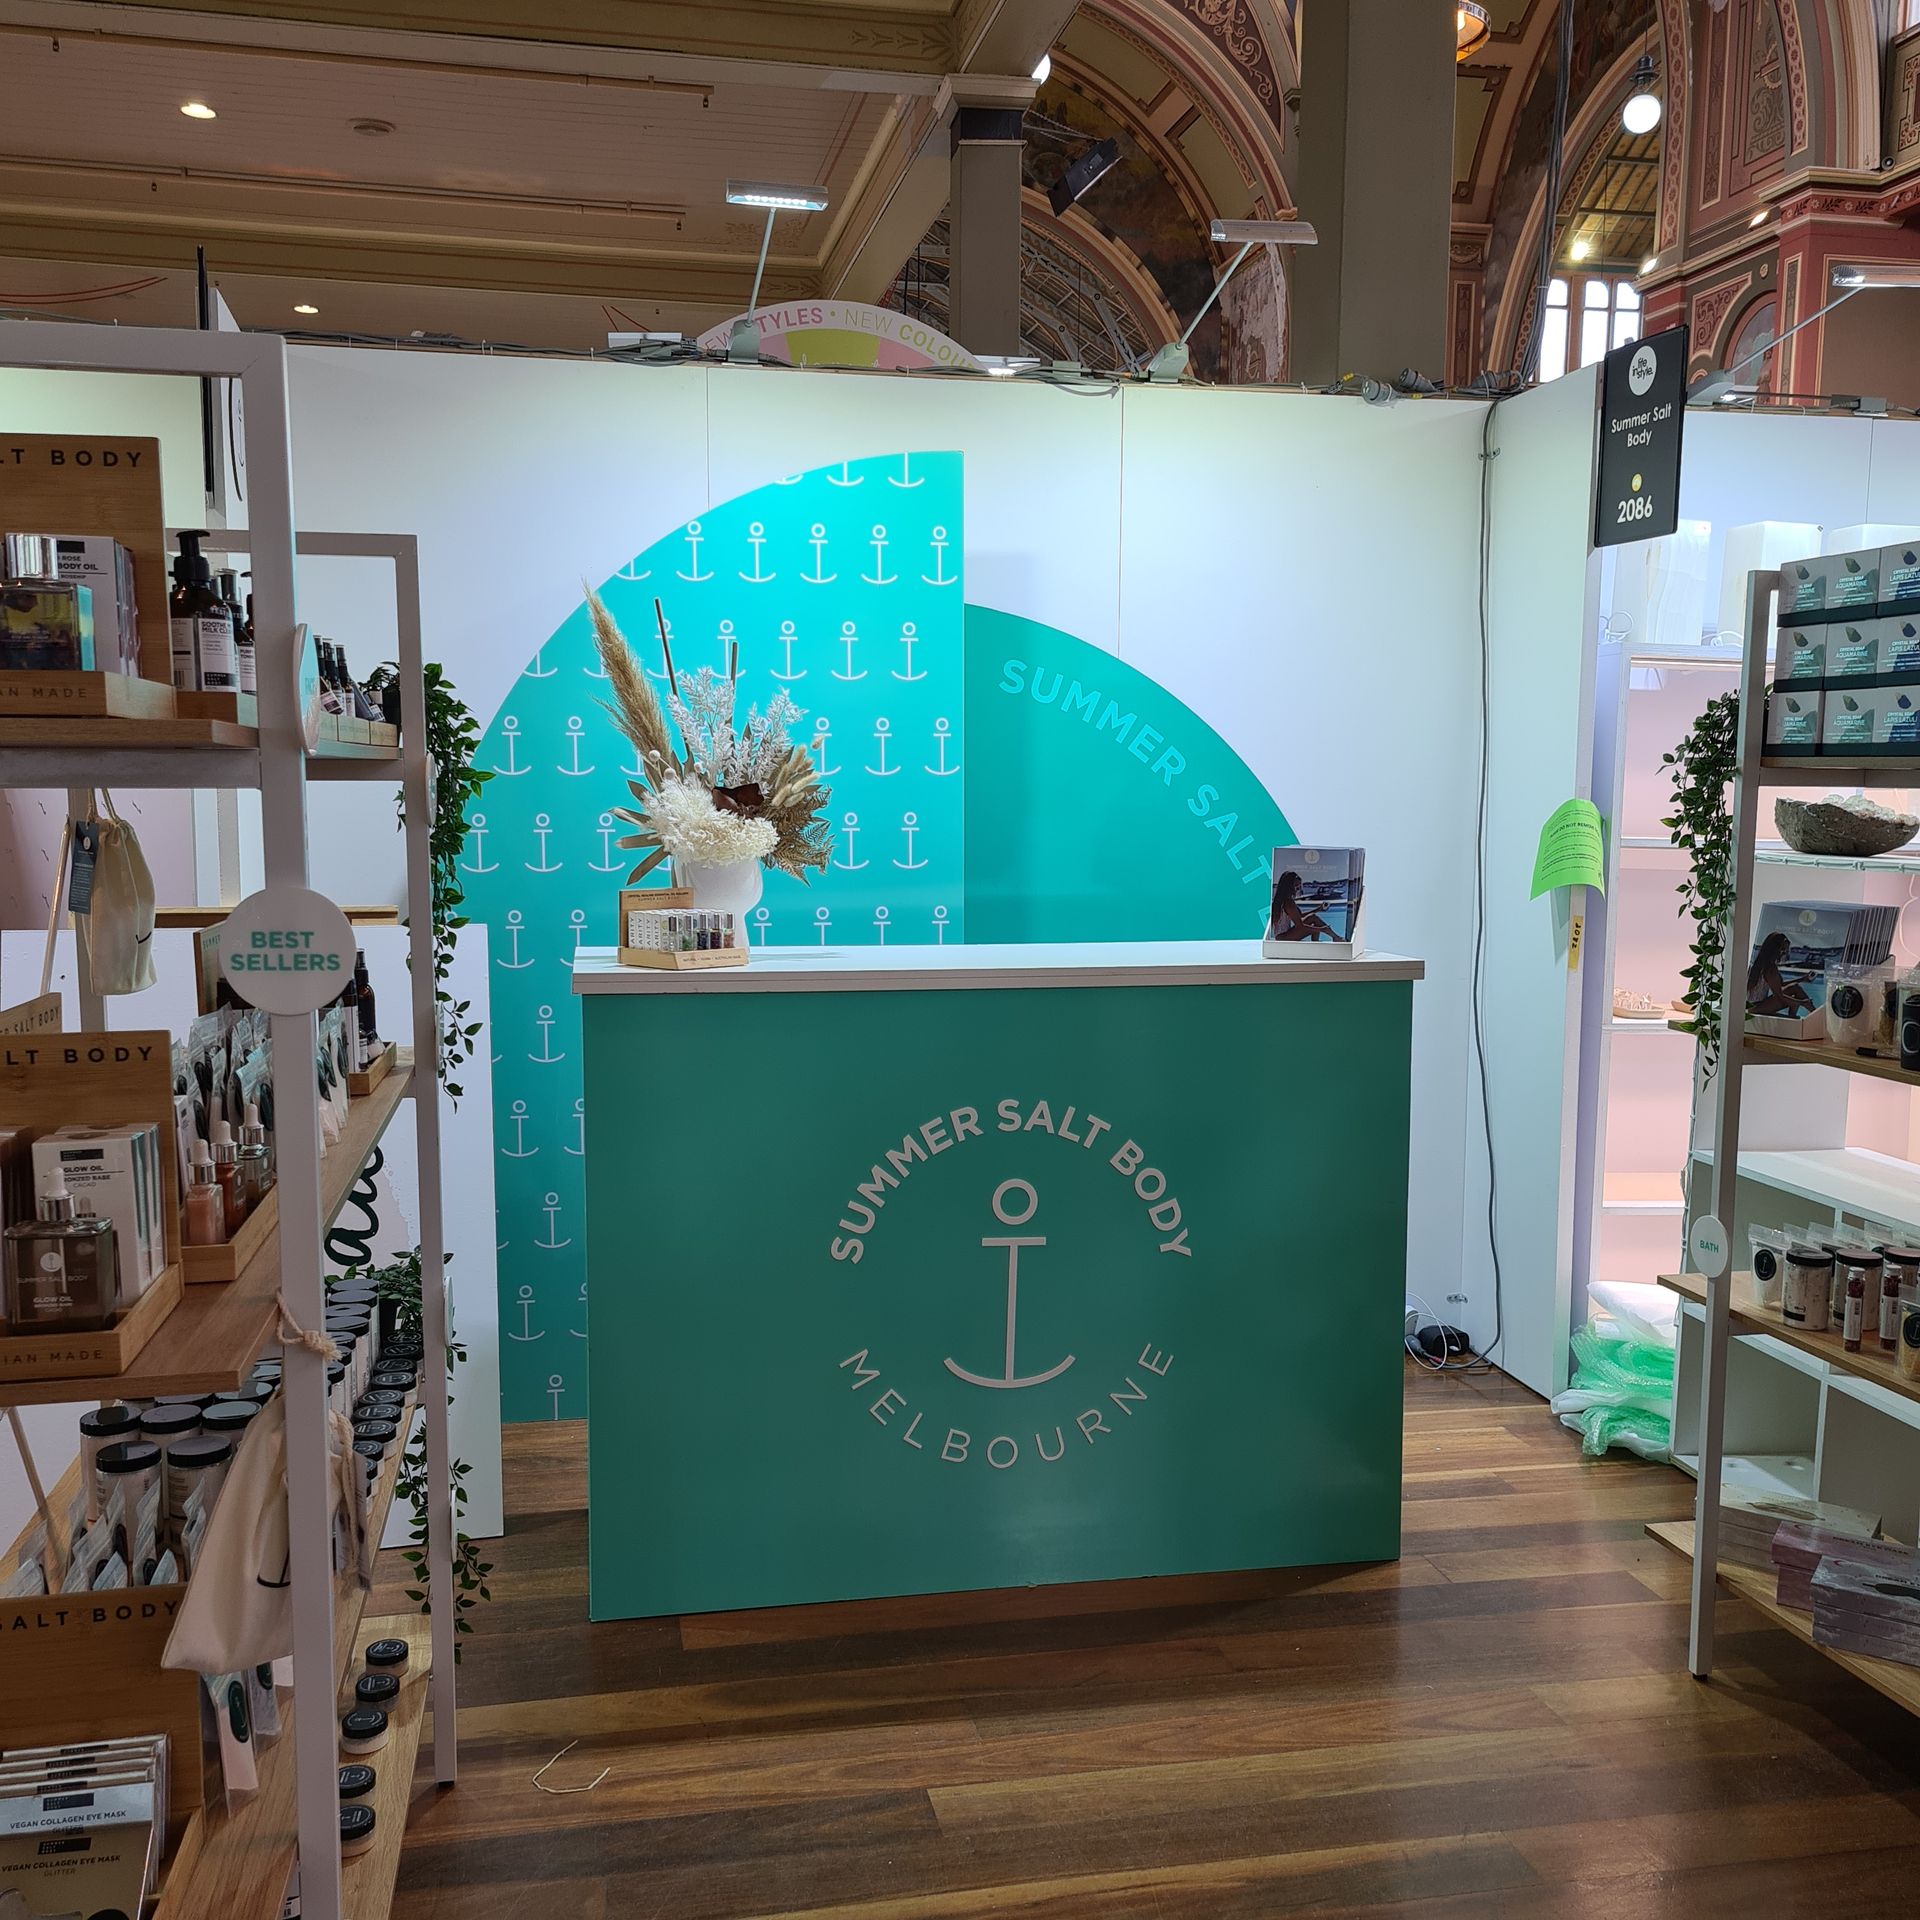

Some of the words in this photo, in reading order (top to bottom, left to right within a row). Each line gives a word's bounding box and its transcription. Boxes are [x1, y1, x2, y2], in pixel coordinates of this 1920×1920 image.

[755, 307, 823, 333] TYLES
[845, 308, 893, 333] NEW
[1611, 411, 1650, 434] Summer
[1652, 403, 1672, 422] Salt
[1627, 430, 1652, 448] Body
[51, 450, 141, 467] BODY
[1616, 495, 1653, 524] 2086
[84, 563, 98, 571] OIL
[33, 688, 88, 698] MADE
[999, 659, 1186, 787] SUMMER
[1187, 784, 1272, 884] SALT
[251, 931, 315, 949] BEST
[231, 953, 341, 971] SELLERS
[14, 1017, 34, 1033] SALT
[39, 1006, 60, 1026] BODY
[64, 1046, 152, 1064] BODY
[830, 1106, 984, 1264] SUMMER
[997, 1098, 1112, 1149] SALT
[1109, 1139, 1192, 1258] BODY
[1700, 1239, 1719, 1253] BATH
[50, 1350, 104, 1361] MADE
[839, 1343, 1175, 1469] MELBOURNE
[93, 1601, 177, 1622] BODY
[10, 1821, 38, 1830] VEGAN
[40, 1816, 85, 1826] COLLAGEN
[104, 1810, 127, 1819] MASK
[2, 1864, 32, 1872] VEGAN
[33, 1859, 78, 1868] COLLAGEN
